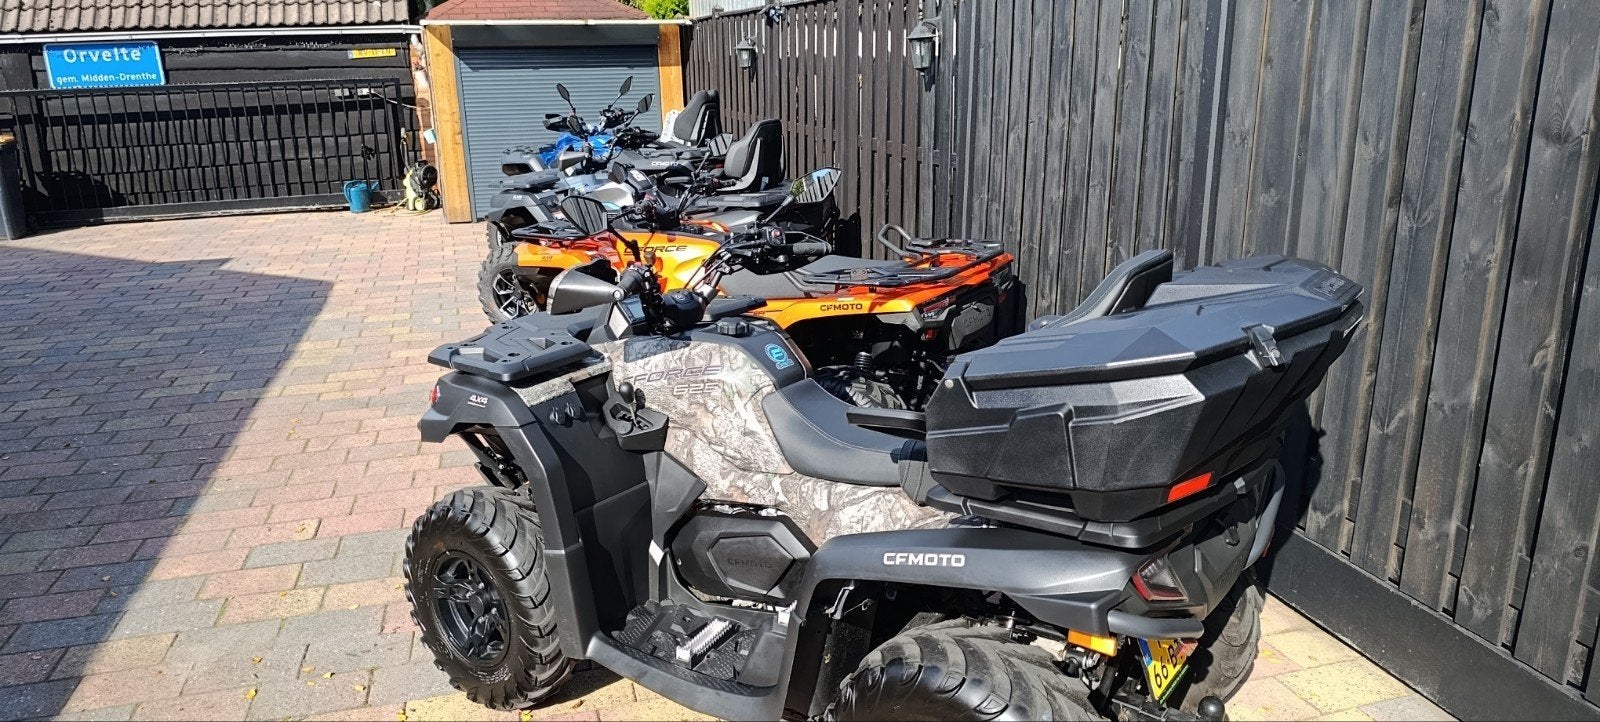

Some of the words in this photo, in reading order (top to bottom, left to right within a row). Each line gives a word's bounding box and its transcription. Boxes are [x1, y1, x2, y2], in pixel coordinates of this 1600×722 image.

[63, 47, 142, 64] Orvelte
[81, 72, 157, 83] Midden-Drenthe
[820, 303, 863, 311] CFMOTO
[883, 552, 966, 568] CFMOTO
